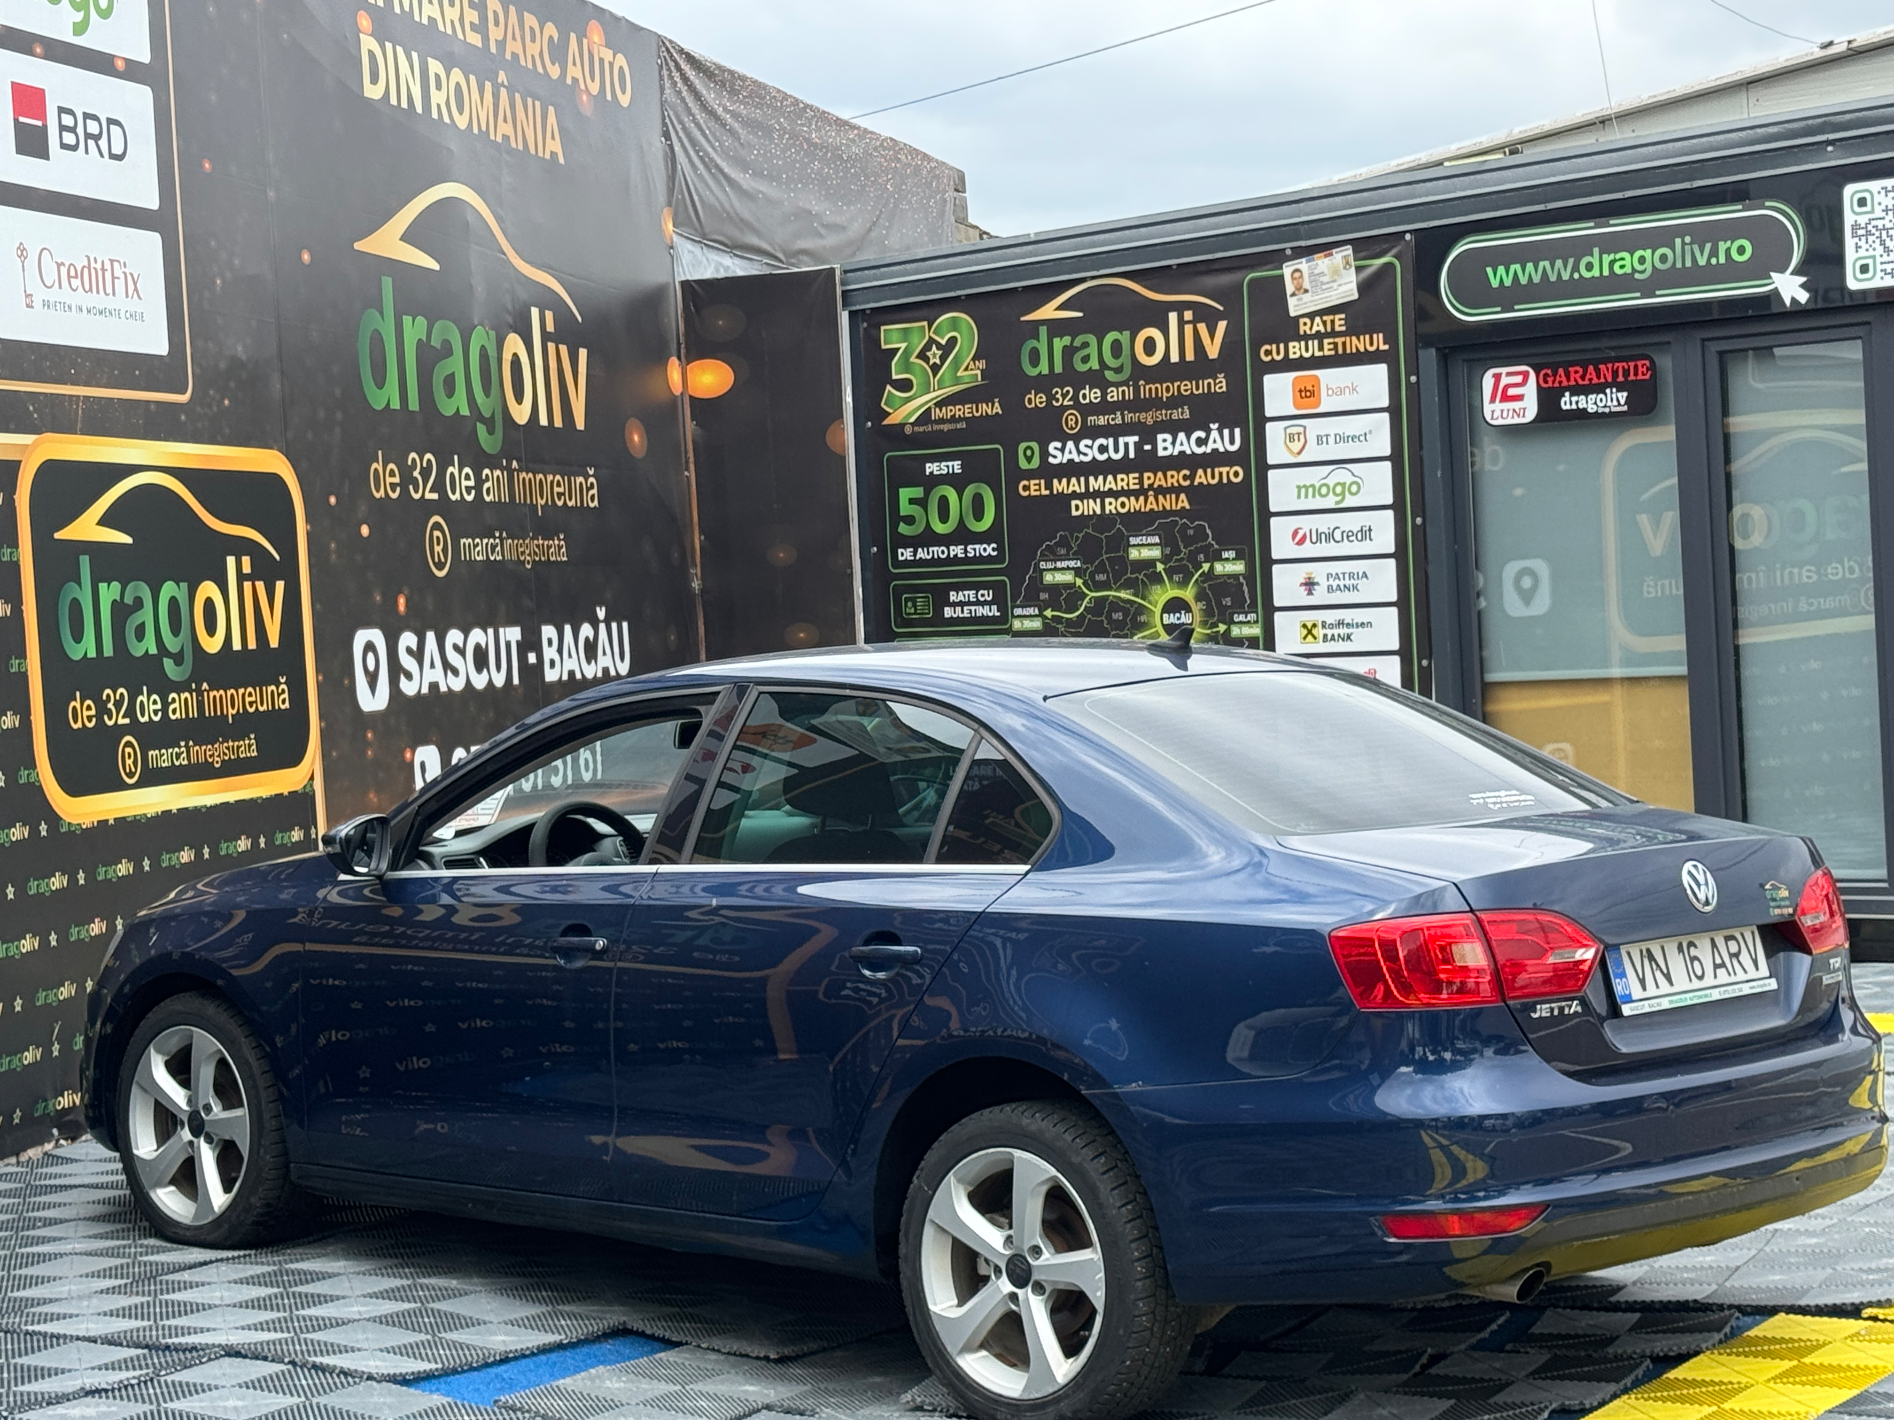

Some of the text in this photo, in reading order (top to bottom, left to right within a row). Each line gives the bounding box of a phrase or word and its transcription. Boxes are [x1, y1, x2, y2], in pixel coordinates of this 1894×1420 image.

[487, 4, 562, 80] PARC
[566, 31, 632, 108] AUTO
[359, 33, 565, 166] DIN ROMÂNIA
[57, 105, 129, 163] BRD
[37, 246, 143, 301] CreditFix
[1486, 236, 1753, 289] www.dragoliv.ro
[41, 298, 145, 323] PRIETEN IN MOMENTE CHEIE
[1299, 313, 1346, 335] RATE
[1020, 311, 1228, 382] dragoliv
[1259, 333, 1390, 362] CU BULETINUL
[358, 275, 588, 455] dragoliv
[880, 311, 983, 416] 32
[968, 360, 986, 371] ANI
[1538, 360, 1652, 388] GARANTIE
[1025, 373, 1227, 409] de 32 de ani împreună
[1298, 382, 1359, 399] tbi bank
[1489, 370, 1530, 405] 12
[930, 398, 1002, 421] ÎMPREUNĂ
[1490, 407, 1526, 421] LUNI
[1560, 388, 1628, 414] dragoliv
[1087, 412, 1122, 427] marcă
[1124, 405, 1190, 426] înregistrată
[1048, 436, 1140, 465] SASCUT
[1157, 423, 1242, 458] BACĂU
[1288, 432, 1302, 443] BT
[1316, 433, 1331, 446] BT
[925, 461, 963, 475] PESTE
[1018, 465, 1245, 497] CEL MAI MARE PARC AUTO
[369, 450, 599, 517] de 32 de ani împreună
[1296, 480, 1361, 506] mogo
[897, 482, 997, 537] 500
[1071, 491, 1190, 517] DIN ROMÂNIA
[1129, 535, 1160, 545] SUCEAVA
[1309, 525, 1373, 545] UniCredit
[460, 530, 502, 562] marcă
[503, 530, 568, 569] înregistrată
[898, 543, 998, 560] DE AUTO PE STOC
[1326, 570, 1369, 583] PATRIA
[1326, 583, 1360, 594] BANK
[950, 590, 993, 602] RATE CU
[58, 554, 285, 682] dragoliv
[944, 605, 1000, 618] BULETINUL
[1163, 610, 1193, 625] BACĂU
[1321, 619, 1373, 631] Raiffeisen
[1322, 632, 1354, 644] BANK
[398, 625, 522, 698] SASCUT
[541, 605, 632, 683] BACĂU
[68, 675, 290, 730] de 32 de ani împreună
[148, 739, 187, 770] marcă
[189, 733, 258, 768] înregistrată
[219, 833, 252, 857] dragoliv
[274, 826, 305, 846] dragoliv
[96, 857, 135, 882] dragoliv
[160, 845, 195, 868] dragoliv
[27, 871, 68, 897] dragoliv
[69, 916, 107, 943] dragoliv
[1626, 928, 1762, 992] VN 16 ARV
[35, 980, 77, 1007] dragoliv
[1616, 979, 1632, 998] RO
[1530, 1001, 1582, 1019] JETTA
[34, 1089, 82, 1118] dragoliv
